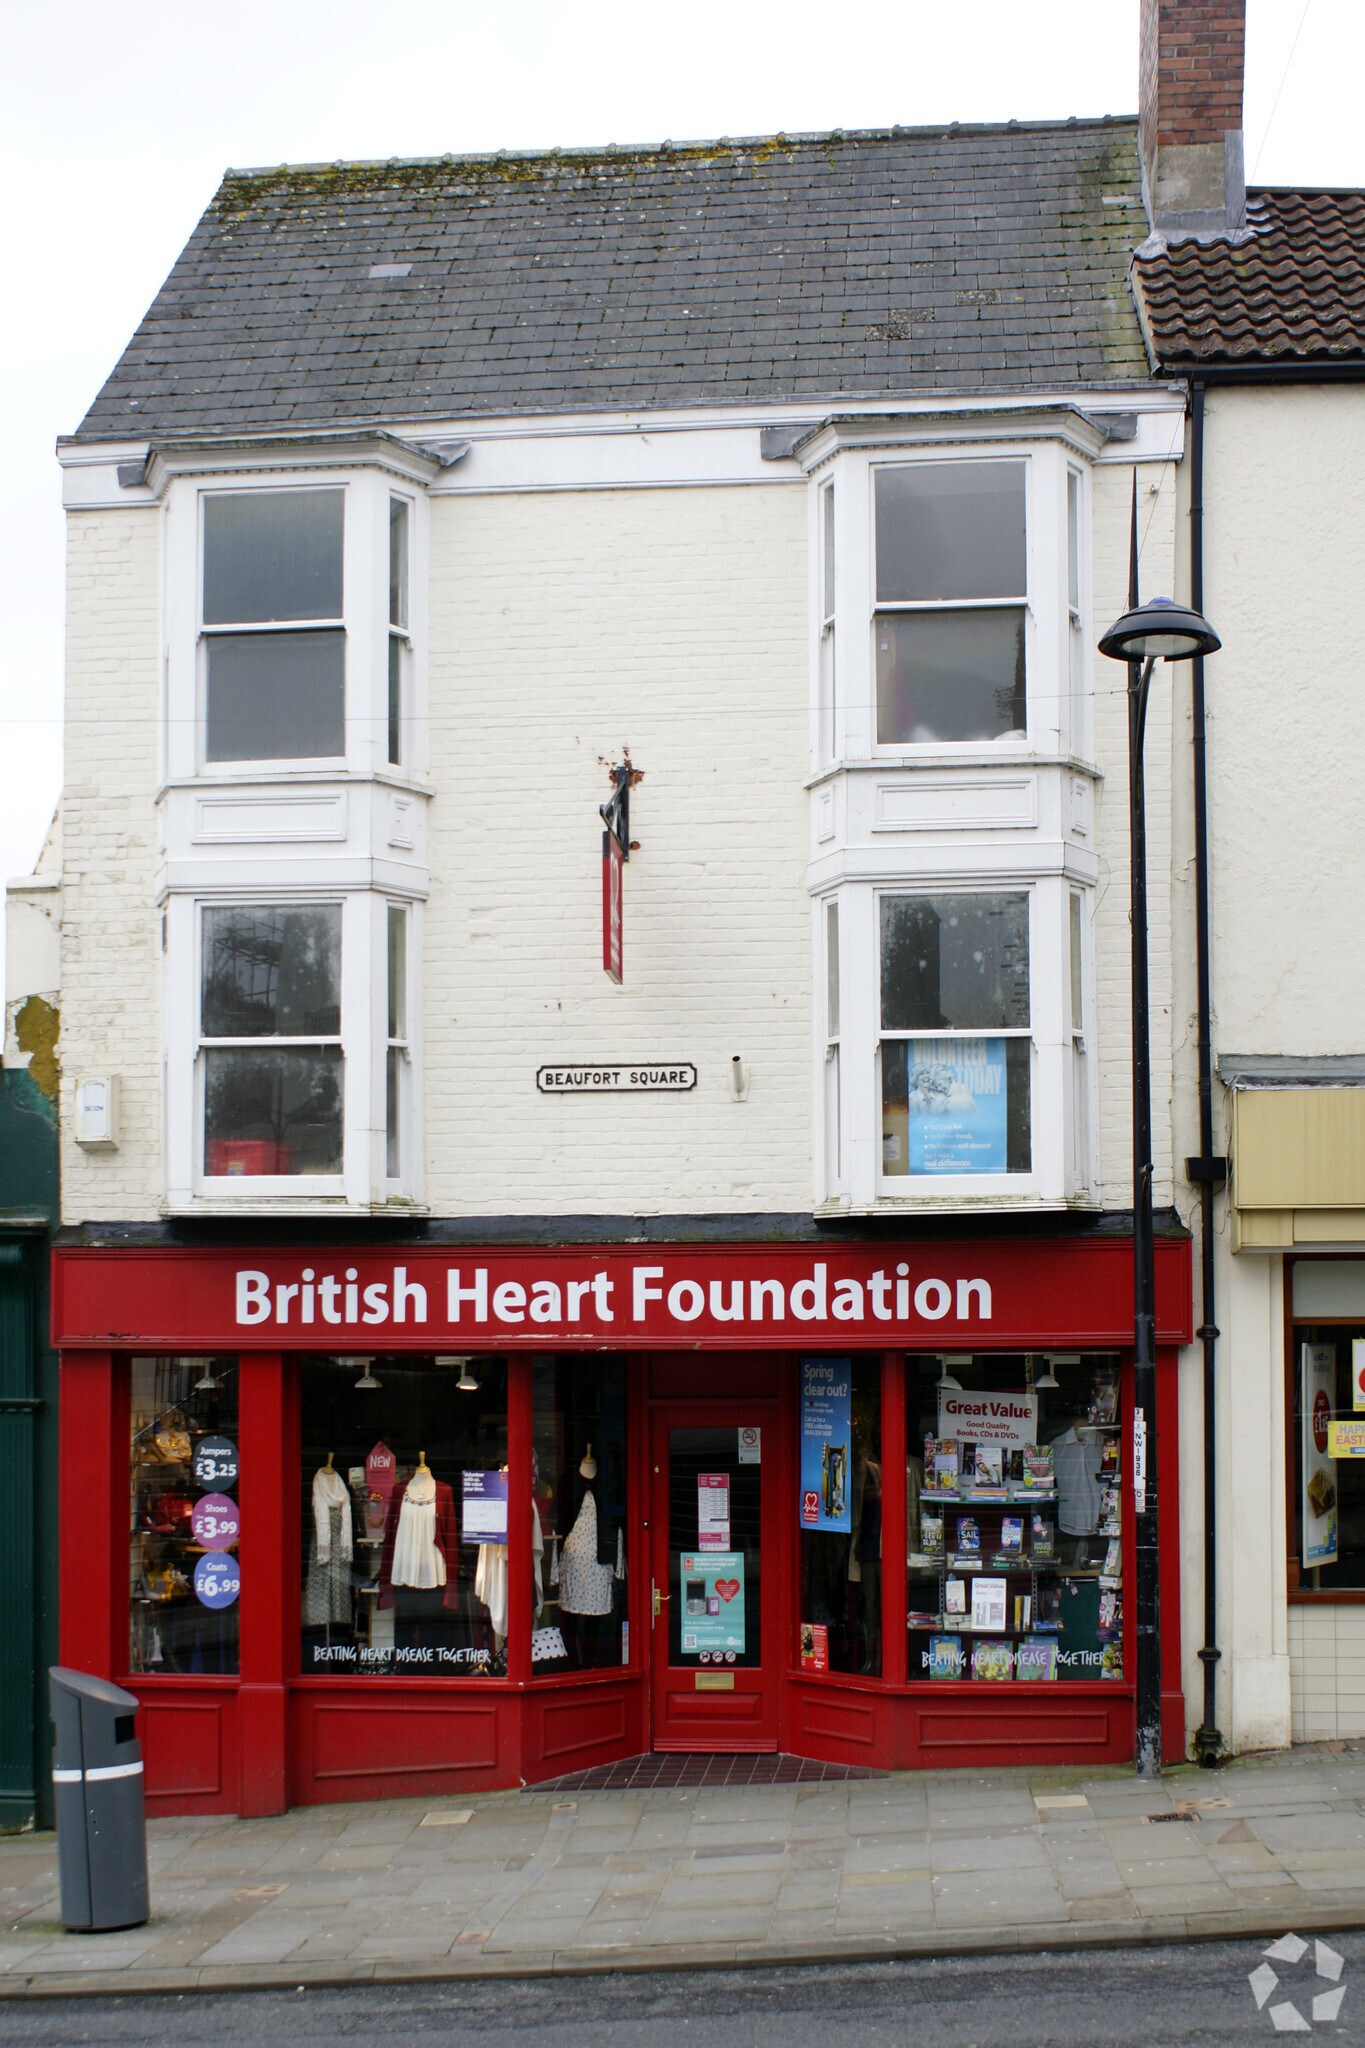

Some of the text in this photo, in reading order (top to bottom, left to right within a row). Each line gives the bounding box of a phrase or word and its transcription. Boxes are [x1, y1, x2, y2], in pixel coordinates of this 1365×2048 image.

[545, 1071, 688, 1085] BEAUFORT SQUARE
[955, 1065, 1002, 1094] TODAY
[236, 1262, 992, 1325] British Heart Foundation
[804, 1364, 834, 1382] Spring
[804, 1382, 848, 1398] clear out?
[946, 1400, 1032, 1418] Great Value
[986, 1422, 1010, 1431] Quality
[1336, 1435, 1365, 1444] EAST
[200, 1447, 232, 1457] Jumpers
[196, 1459, 237, 1480] £3.25
[370, 1456, 390, 1469] NEW
[205, 1504, 228, 1513] Shoes
[196, 1516, 238, 1538] £3.99
[960, 1530, 978, 1539] SAIL
[206, 1562, 228, 1571] Coats
[196, 1575, 240, 1597] £6.99
[314, 1646, 492, 1664] BEATING HEART DISEASE TOGETHER
[922, 1651, 966, 1668] BEATING
[971, 1651, 1004, 1666] HEART
[1008, 1651, 1047, 1666] DISEASE
[1052, 1650, 1106, 1666] TOGETHER
